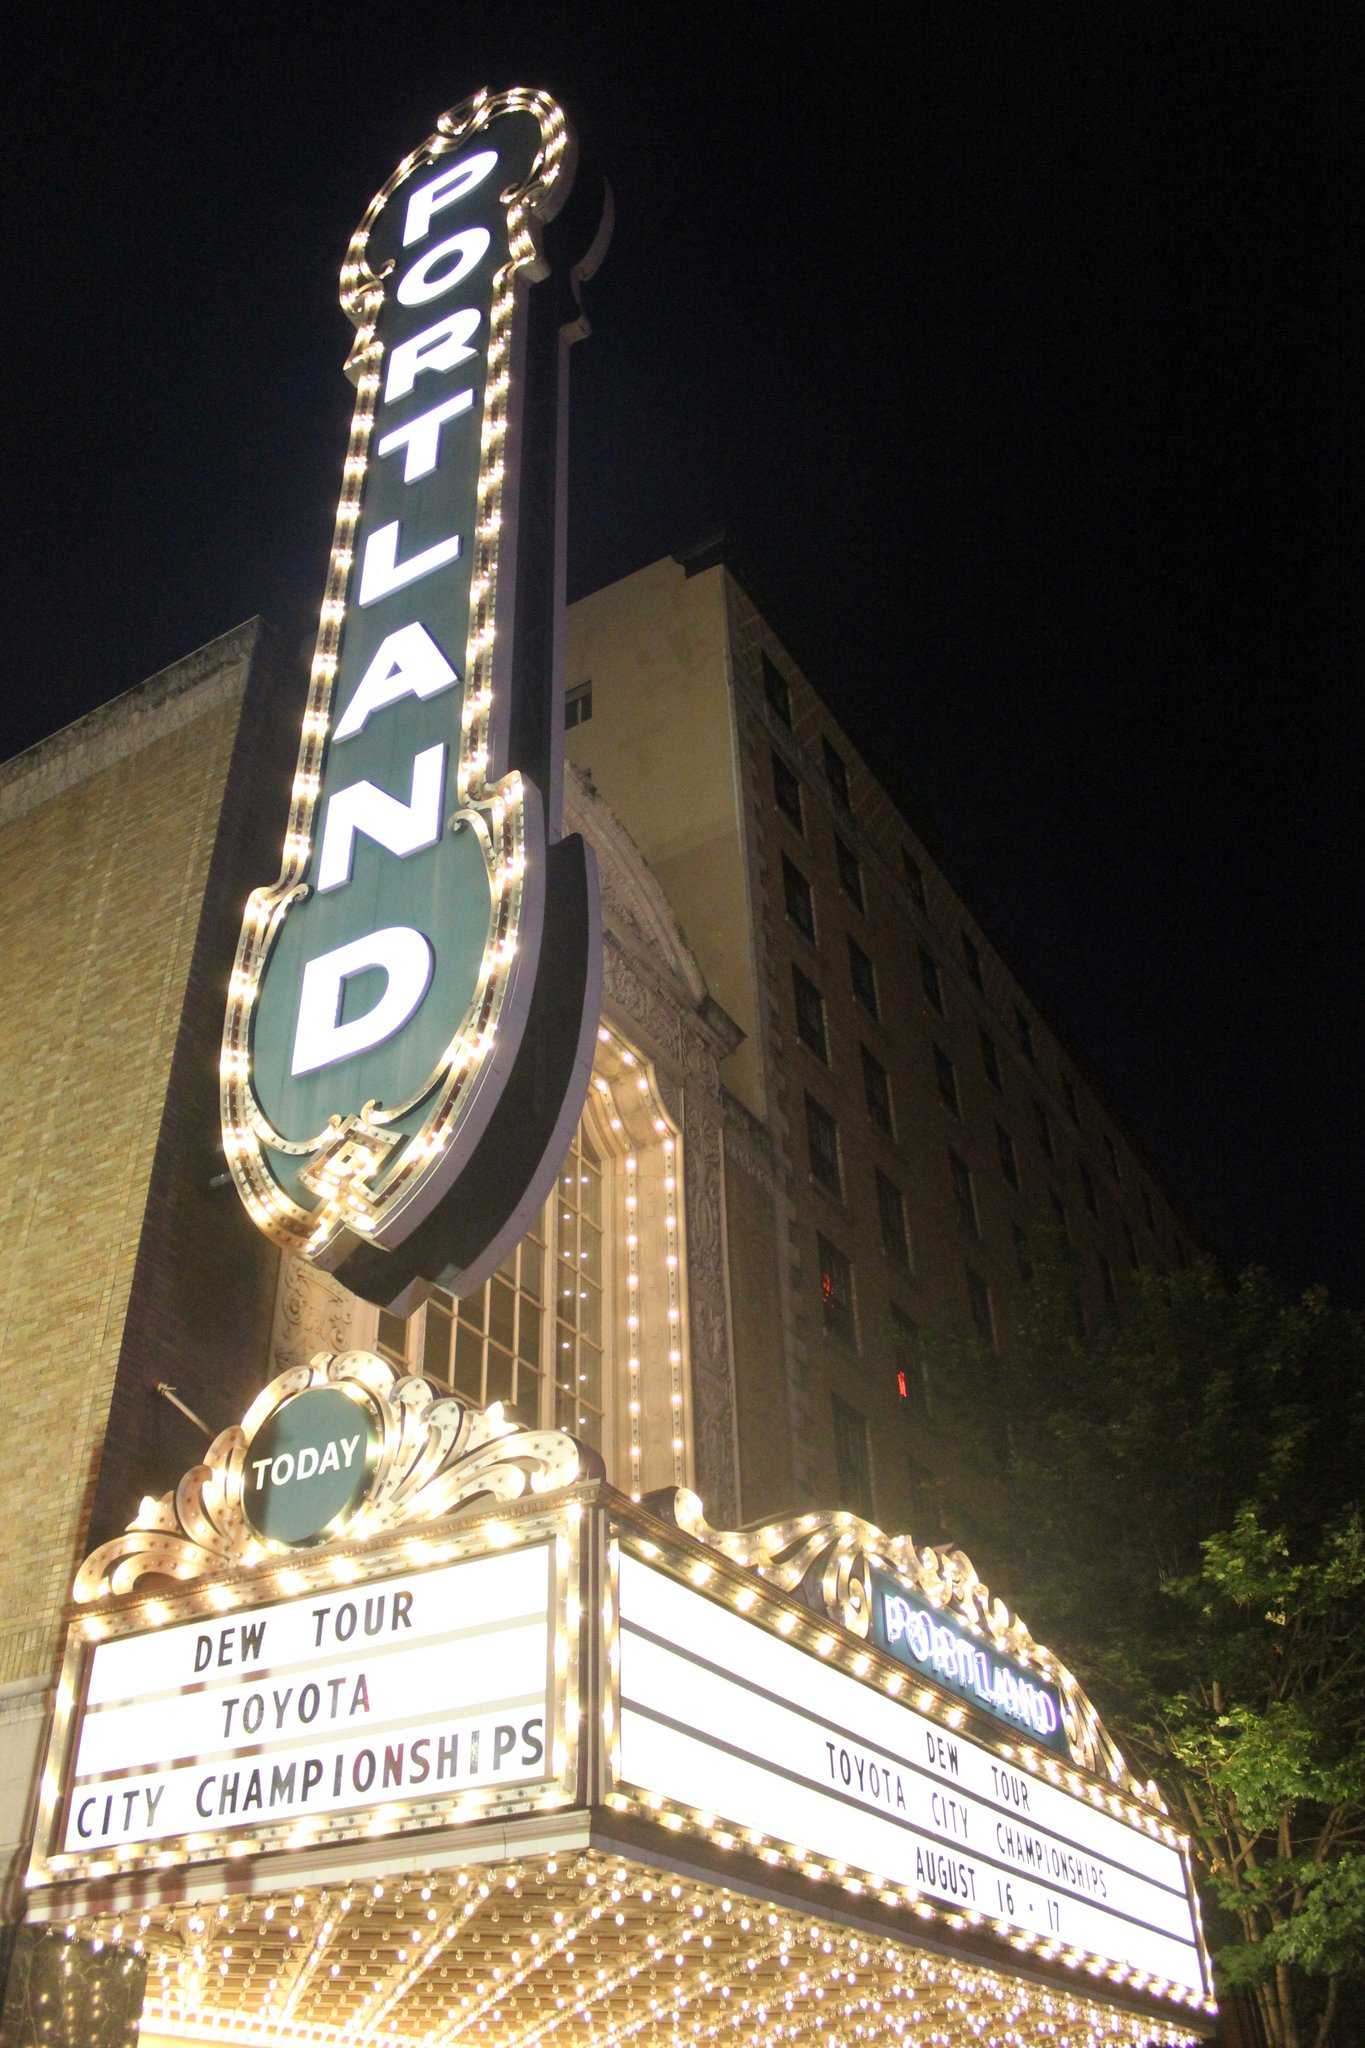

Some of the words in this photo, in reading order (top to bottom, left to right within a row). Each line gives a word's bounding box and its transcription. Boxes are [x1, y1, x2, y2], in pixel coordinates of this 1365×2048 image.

[291, 149, 499, 1078] PORTLAND
[252, 1435, 360, 1490] TODAY
[193, 1621, 266, 1672] DEW
[312, 1591, 414, 1647] TOUR
[884, 1593, 1057, 1735] PORTLAND
[221, 1674, 370, 1738] TOYOTA
[76, 1785, 165, 1838] CITY
[196, 1719, 544, 1818] CHAMPIONSHIPS
[925, 1731, 959, 1776] DEW
[991, 1766, 1031, 1811] TOUR
[825, 1741, 906, 1809] TOYOTA
[931, 1792, 969, 1839] CITY
[996, 1823, 1107, 1897] CHAMPIONSHIPS
[916, 1847, 977, 1901] AUGUST
[996, 1880, 1016, 1915] 16
[1046, 1898, 1061, 1932] 17
